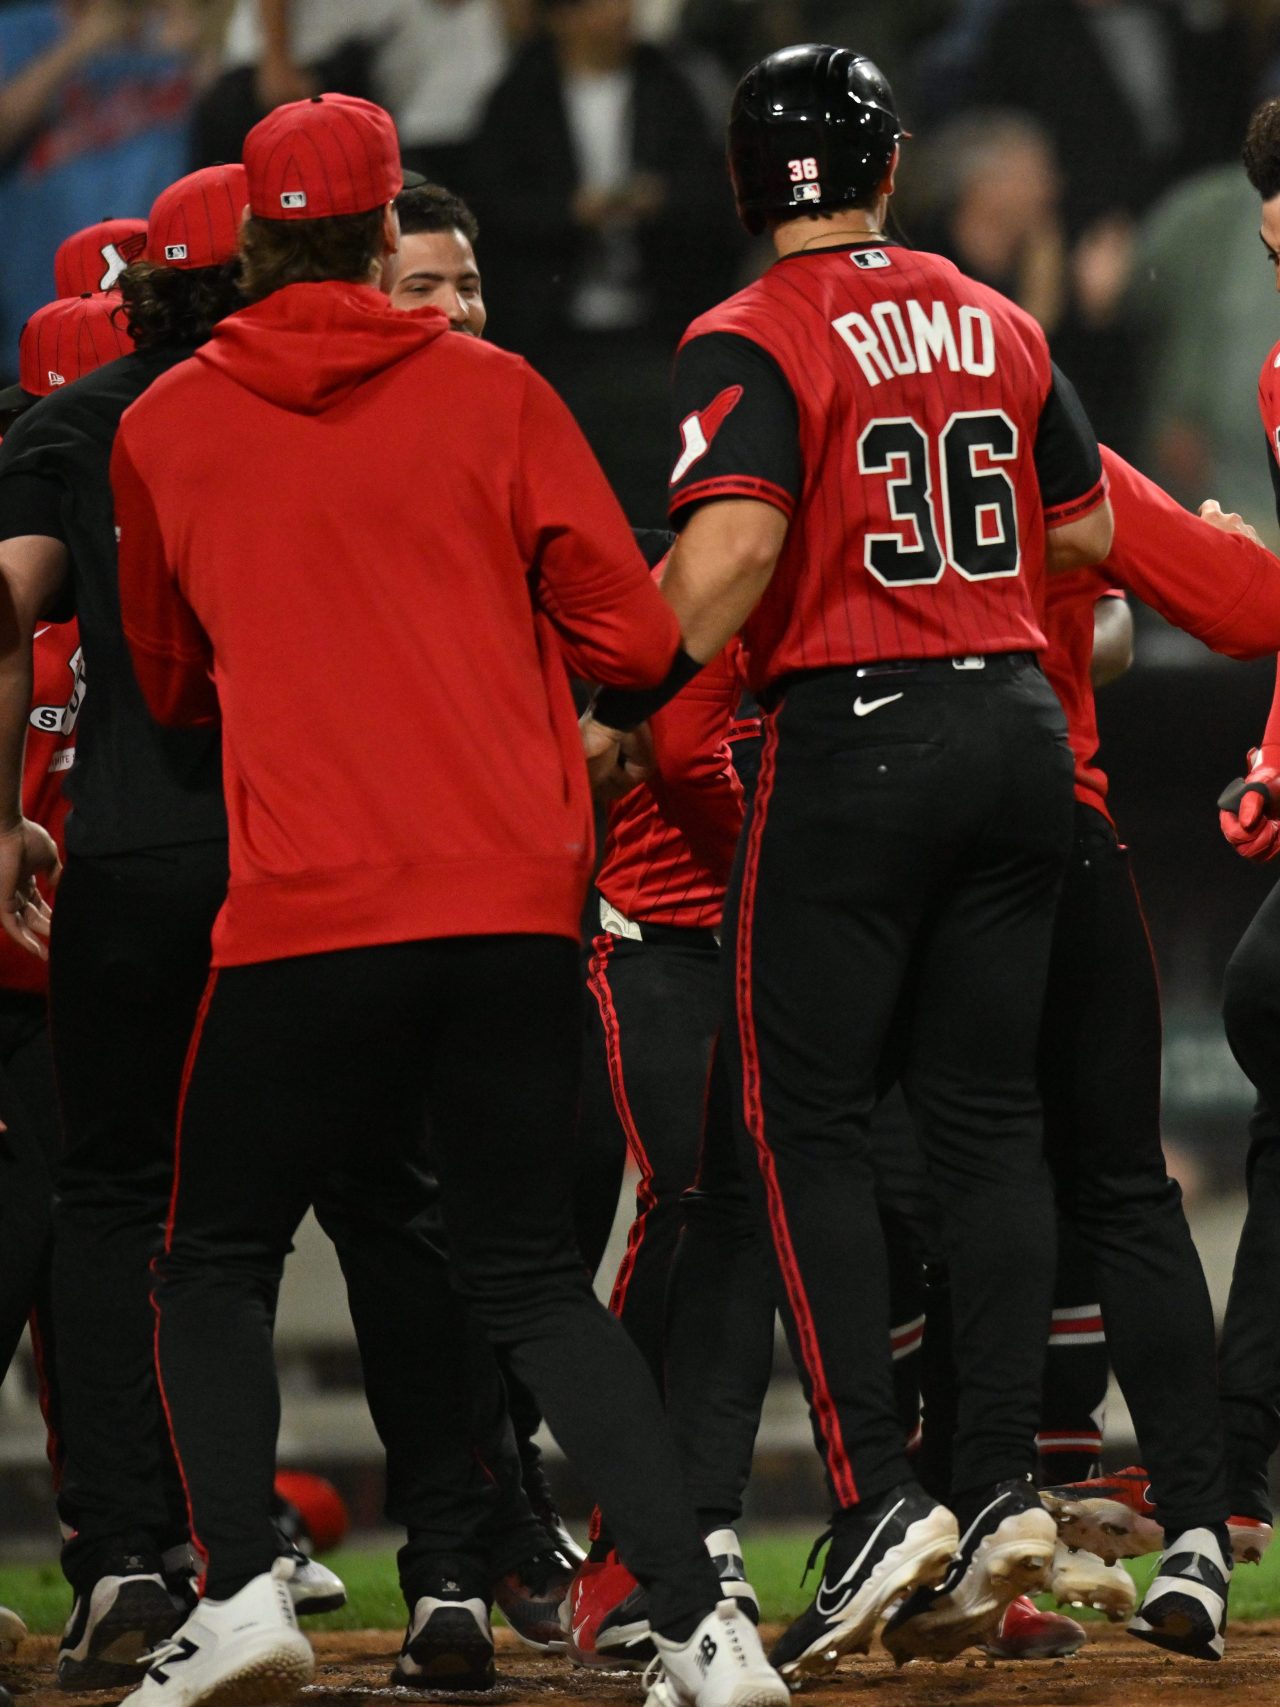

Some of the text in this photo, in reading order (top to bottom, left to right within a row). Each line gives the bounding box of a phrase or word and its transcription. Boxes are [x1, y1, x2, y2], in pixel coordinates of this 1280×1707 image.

[787, 157, 819, 182] 36
[831, 299, 996, 387] ROMO
[856, 408, 1022, 588] 36
